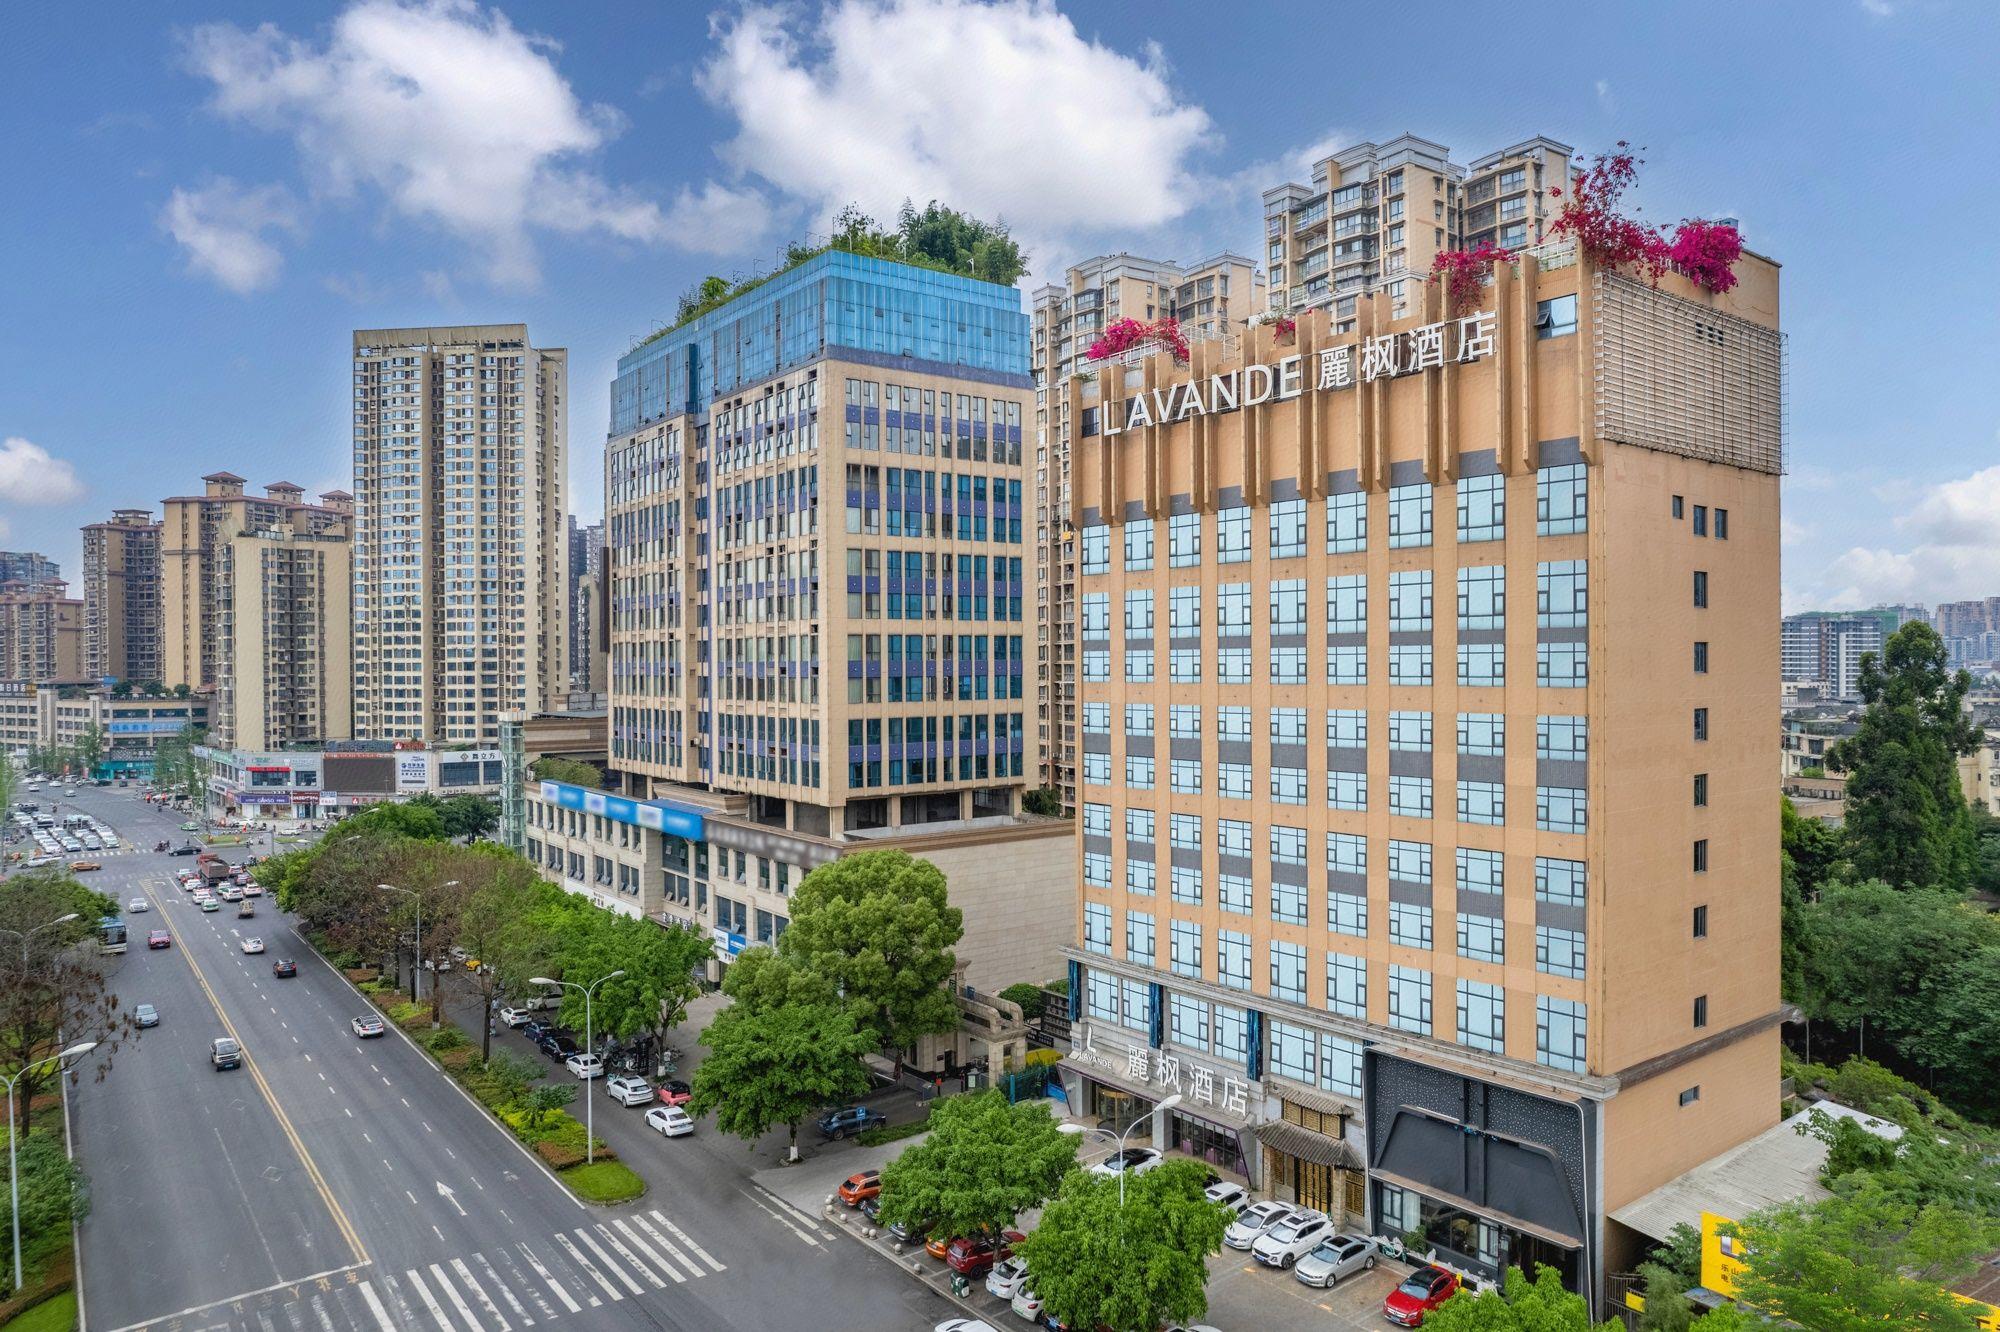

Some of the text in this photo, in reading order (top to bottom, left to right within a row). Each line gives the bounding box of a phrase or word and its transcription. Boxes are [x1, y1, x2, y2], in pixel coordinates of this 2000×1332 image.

[1316, 310, 1498, 391] 麗枫酒店
[1102, 353, 1302, 437] LAVANDE
[1078, 1051, 1112, 1070] LAVANDE
[1128, 1044, 1249, 1117] 麗枫酒店
